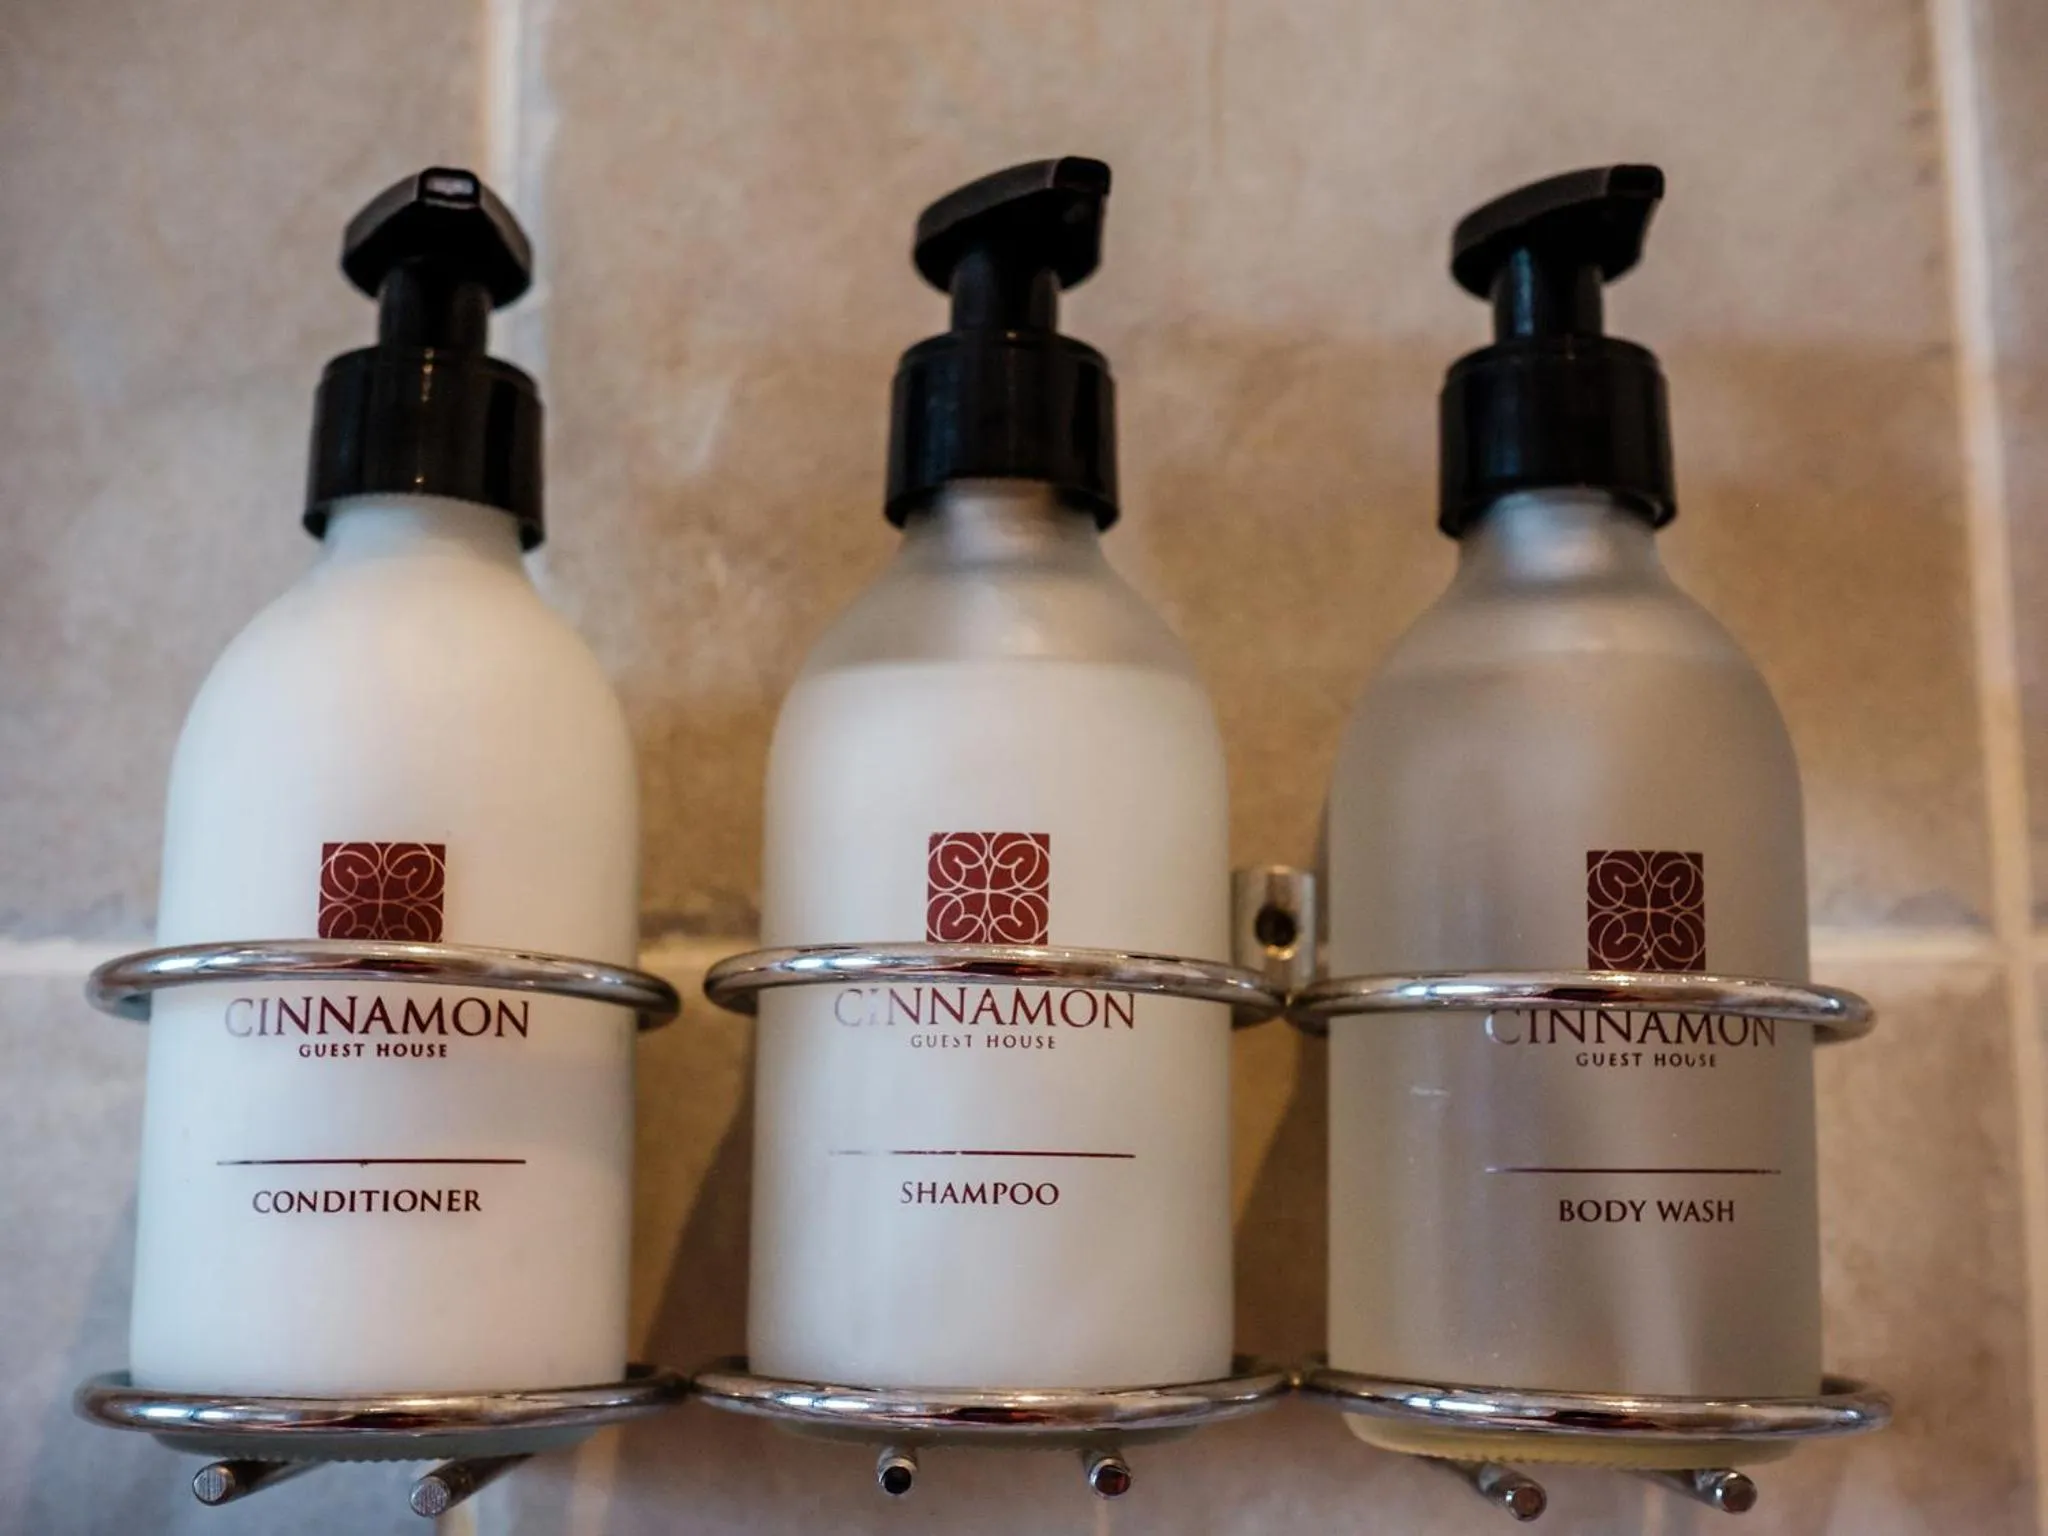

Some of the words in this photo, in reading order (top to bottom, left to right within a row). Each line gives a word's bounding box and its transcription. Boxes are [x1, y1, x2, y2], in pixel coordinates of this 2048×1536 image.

[225, 996, 529, 1038] CINNAMON
[834, 987, 1136, 1029] CINNAMON
[1485, 1009, 1776, 1047] CINNAMON
[299, 1043, 365, 1058] GUEST
[376, 1043, 448, 1058] HOUSE
[911, 1034, 972, 1049] GUEST
[986, 1035, 1057, 1050] HOUSE
[1576, 1052, 1644, 1067] GUEST
[1654, 1052, 1717, 1068] HOUSE
[252, 1189, 482, 1214] CONDITIONER
[900, 1181, 1060, 1205] SHAMPOO
[1559, 1200, 1647, 1223] BODY
[1656, 1200, 1735, 1223] WASH
